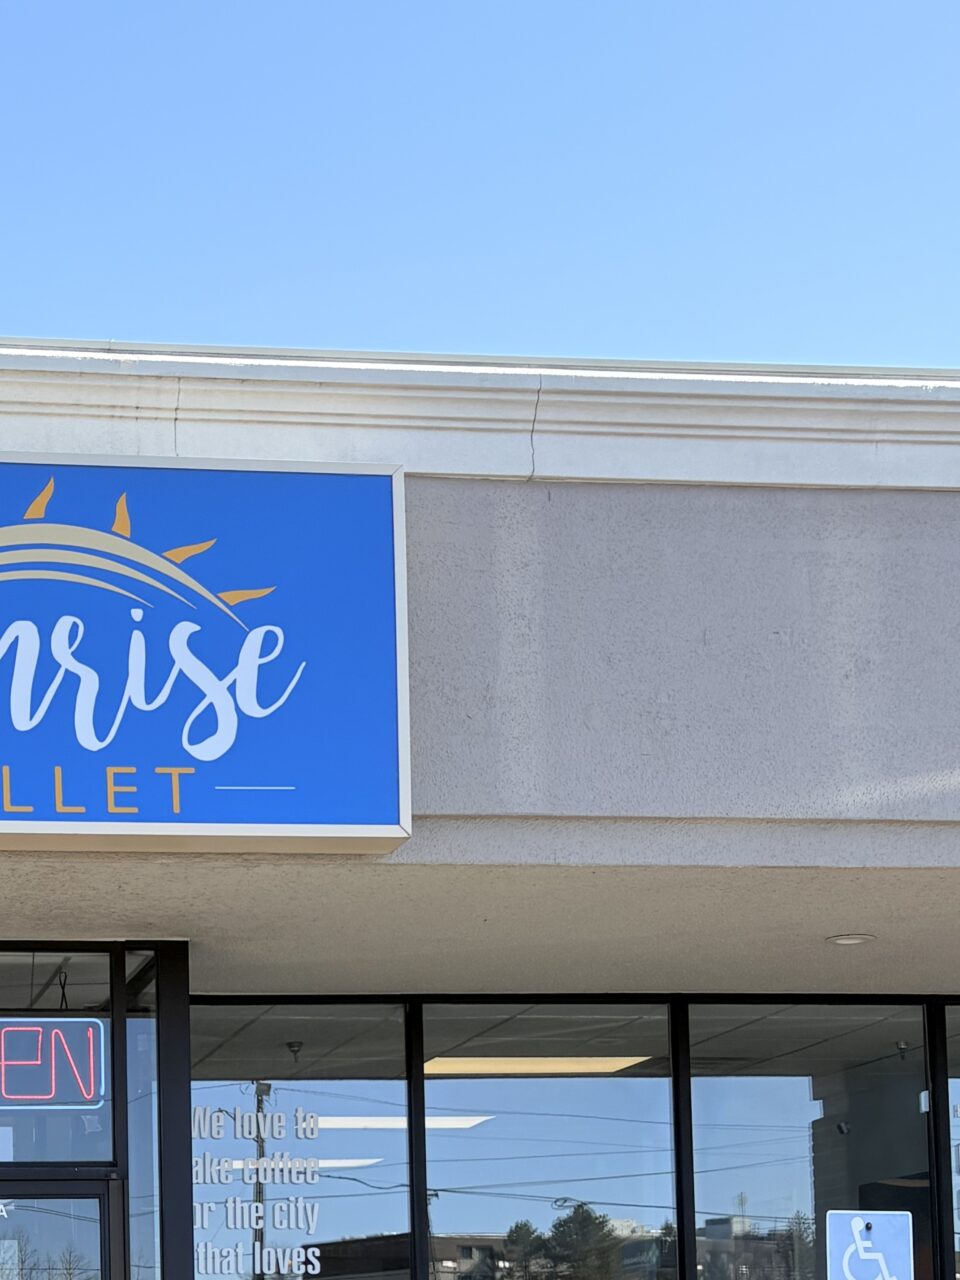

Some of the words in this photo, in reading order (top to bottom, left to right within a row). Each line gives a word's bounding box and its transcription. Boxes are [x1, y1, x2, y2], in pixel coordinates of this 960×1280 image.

[191, 1106, 224, 1139] We
[234, 1106, 286, 1139] love
[295, 1107, 319, 1139] to
[192, 1152, 233, 1184] ake
[243, 1152, 320, 1184] coffee
[193, 1202, 216, 1229] or
[226, 1197, 264, 1229] the
[273, 1197, 319, 1235] city
[196, 1242, 244, 1274] that
[253, 1241, 321, 1275] loves
